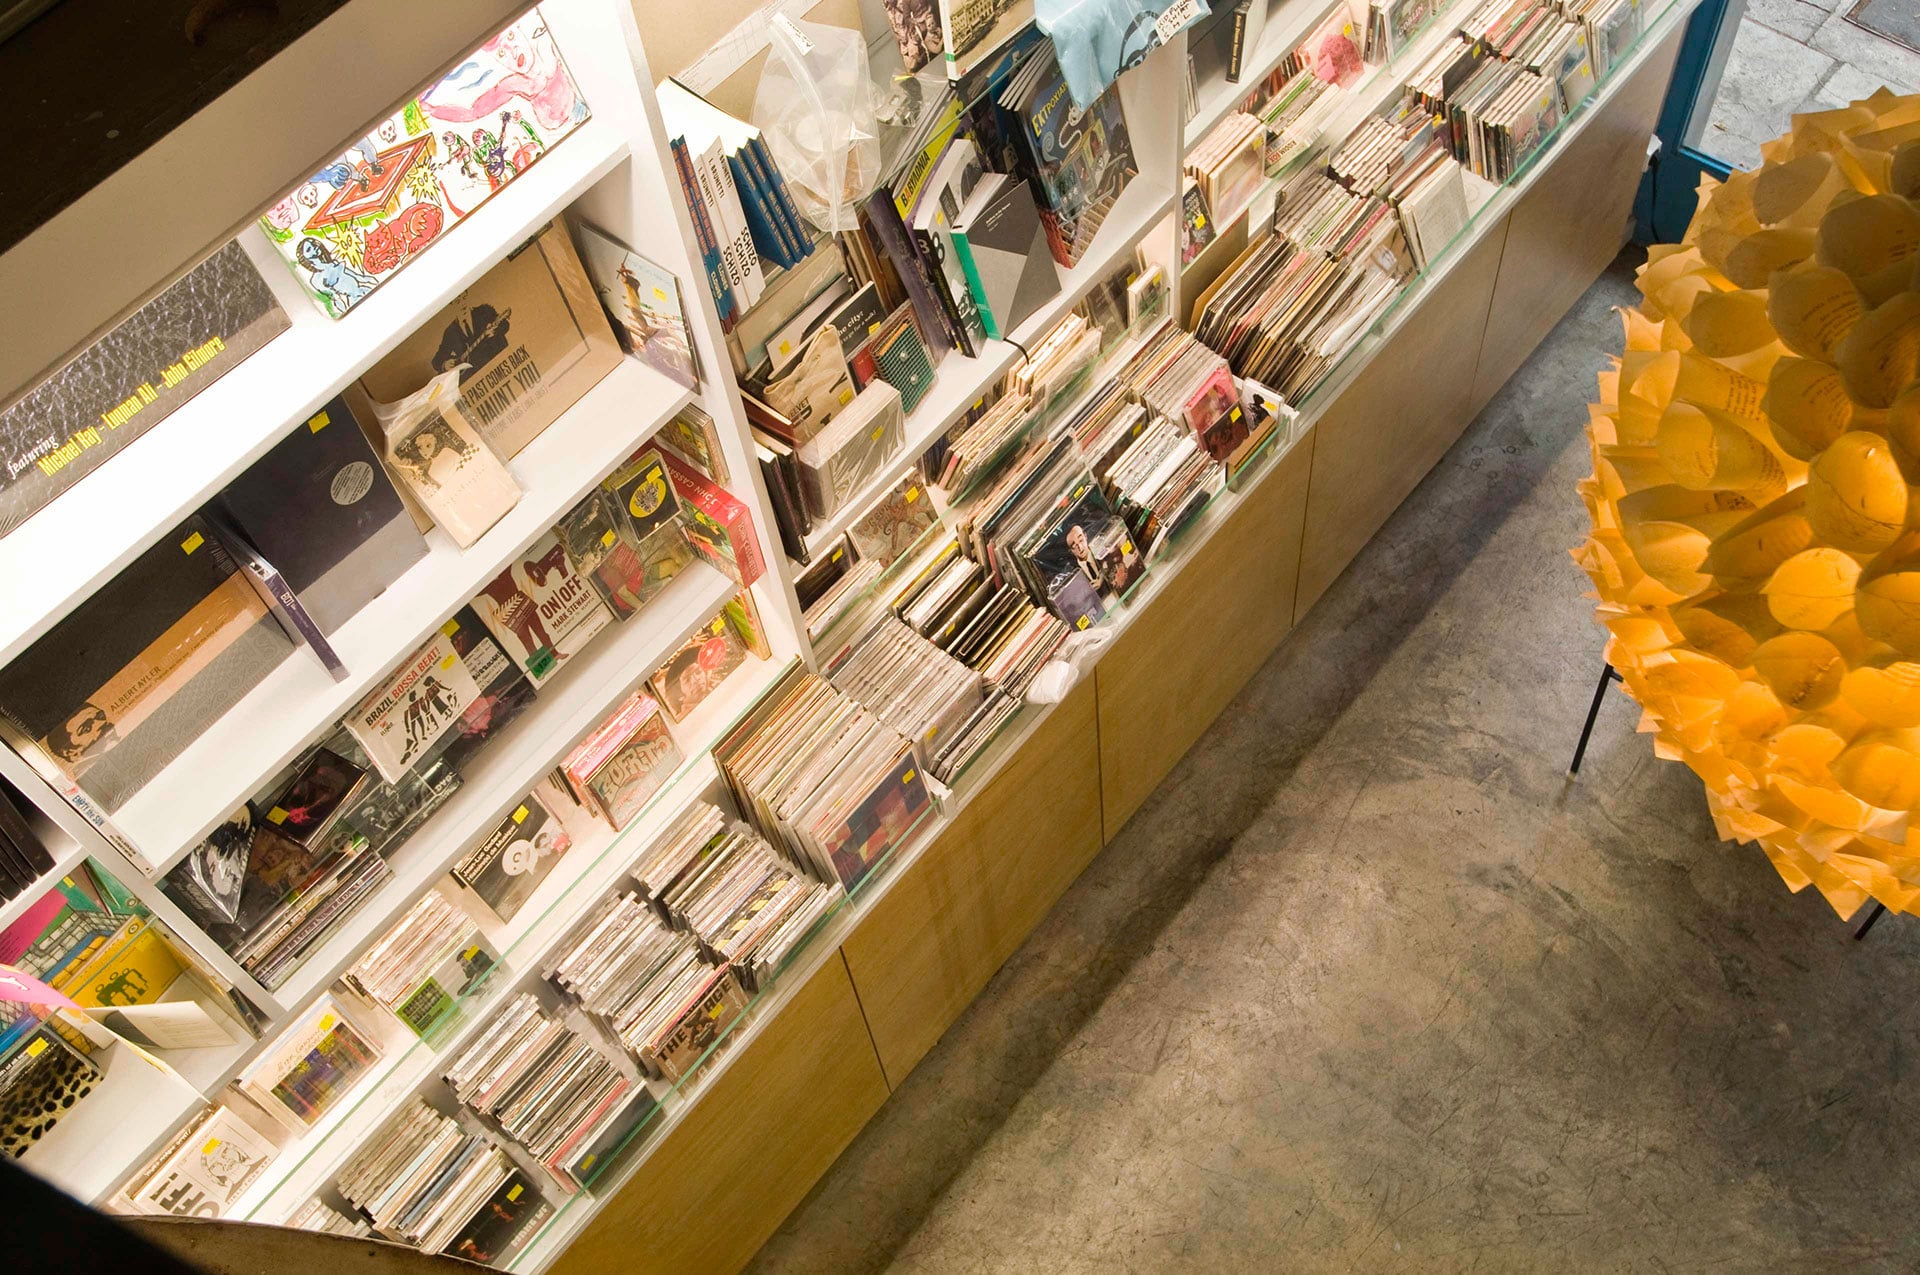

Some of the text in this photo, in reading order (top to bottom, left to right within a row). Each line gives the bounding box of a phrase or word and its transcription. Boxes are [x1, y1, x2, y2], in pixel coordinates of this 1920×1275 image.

[722, 246, 740, 286] SCHIZO
[733, 237, 751, 277] SCHIZO
[740, 226, 757, 267] SCHIZO
[467, 377, 491, 408] PAST
[486, 360, 514, 390] COMES
[508, 344, 530, 369] BACK
[476, 361, 542, 424] HAUNT YOU
[37, 336, 226, 477] Michael Ray Luqman Ali John Gilmore
[7, 434, 59, 480] featuring
[551, 590, 592, 630] MARK STEWART
[111, 665, 162, 712] ALBERT AYLER
[365, 646, 442, 727] BRAZIL BOSSA BEAT!
[656, 1026, 689, 1062] THE
